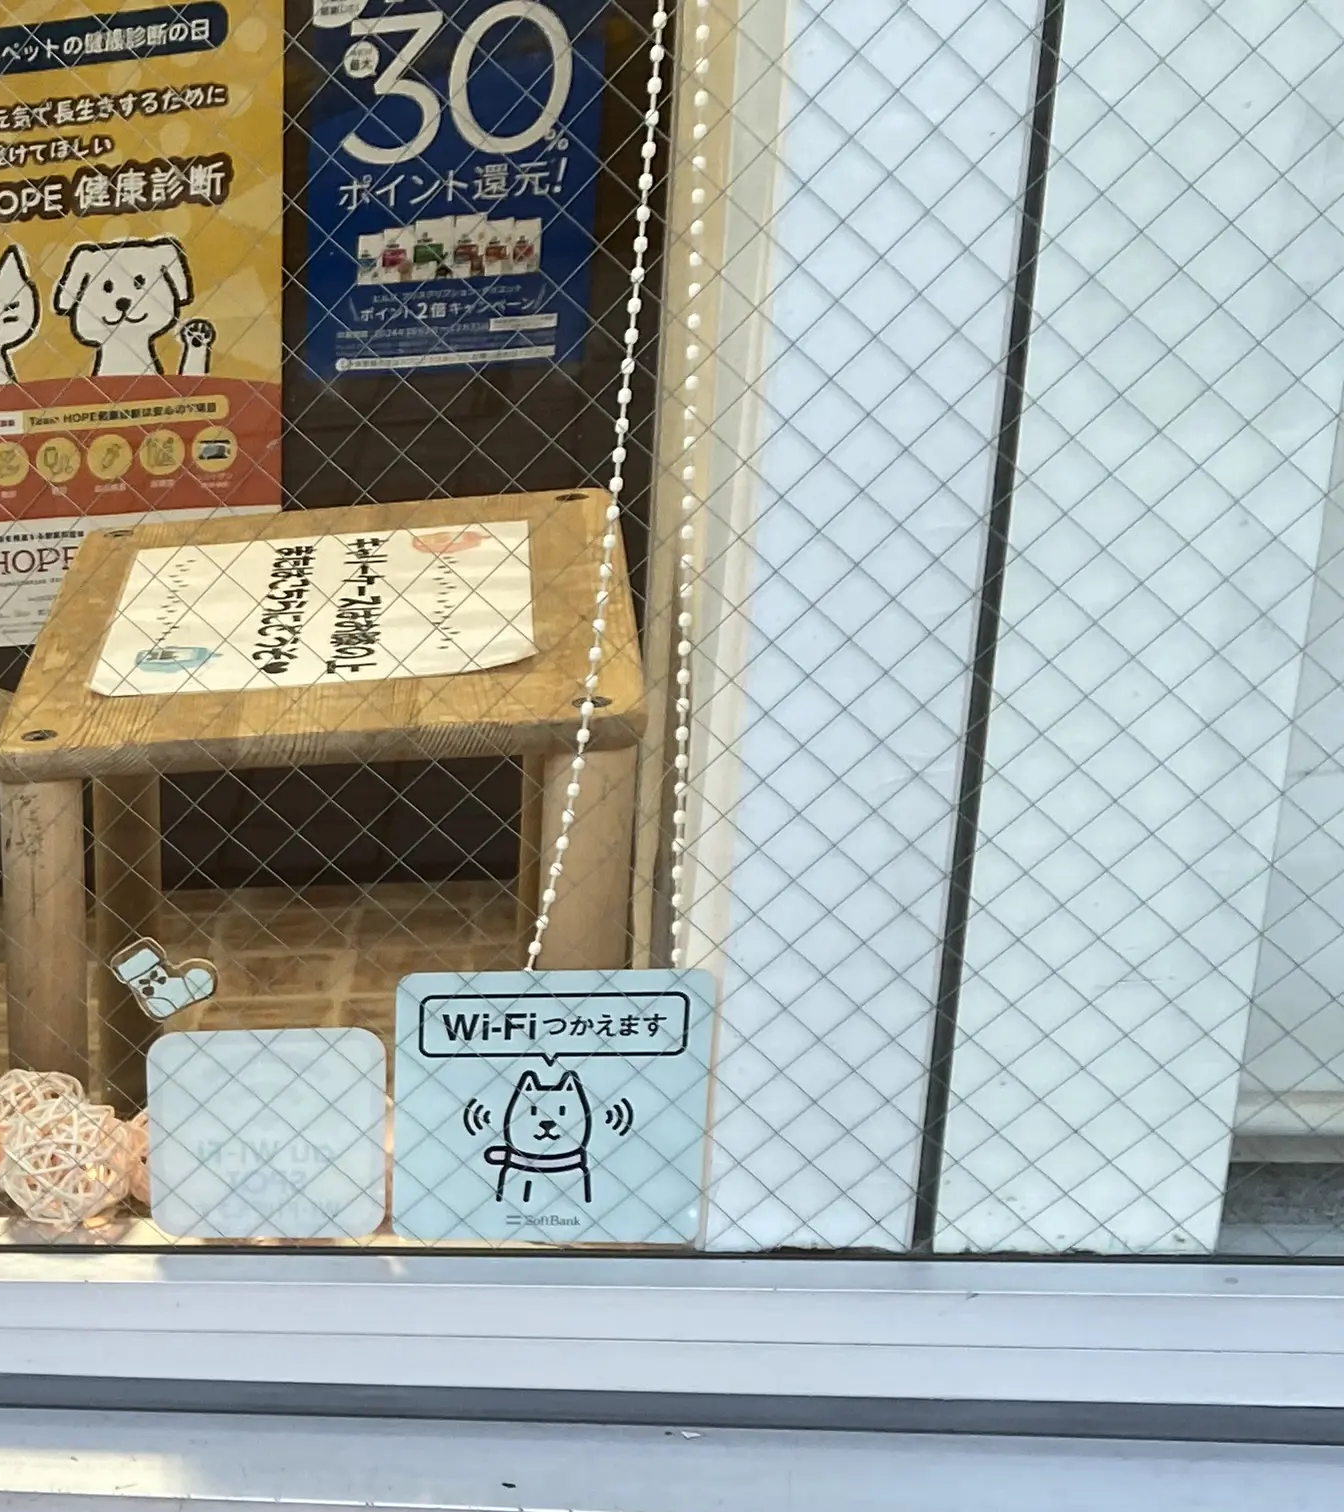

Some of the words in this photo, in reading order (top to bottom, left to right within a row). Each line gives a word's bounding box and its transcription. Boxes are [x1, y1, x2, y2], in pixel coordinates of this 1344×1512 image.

[74, 161, 226, 208] 健康診断
[442, 1012, 537, 1041] Wi-Fi
[542, 1013, 668, 1038] つかえます
[524, 1214, 581, 1227] SoftBank
